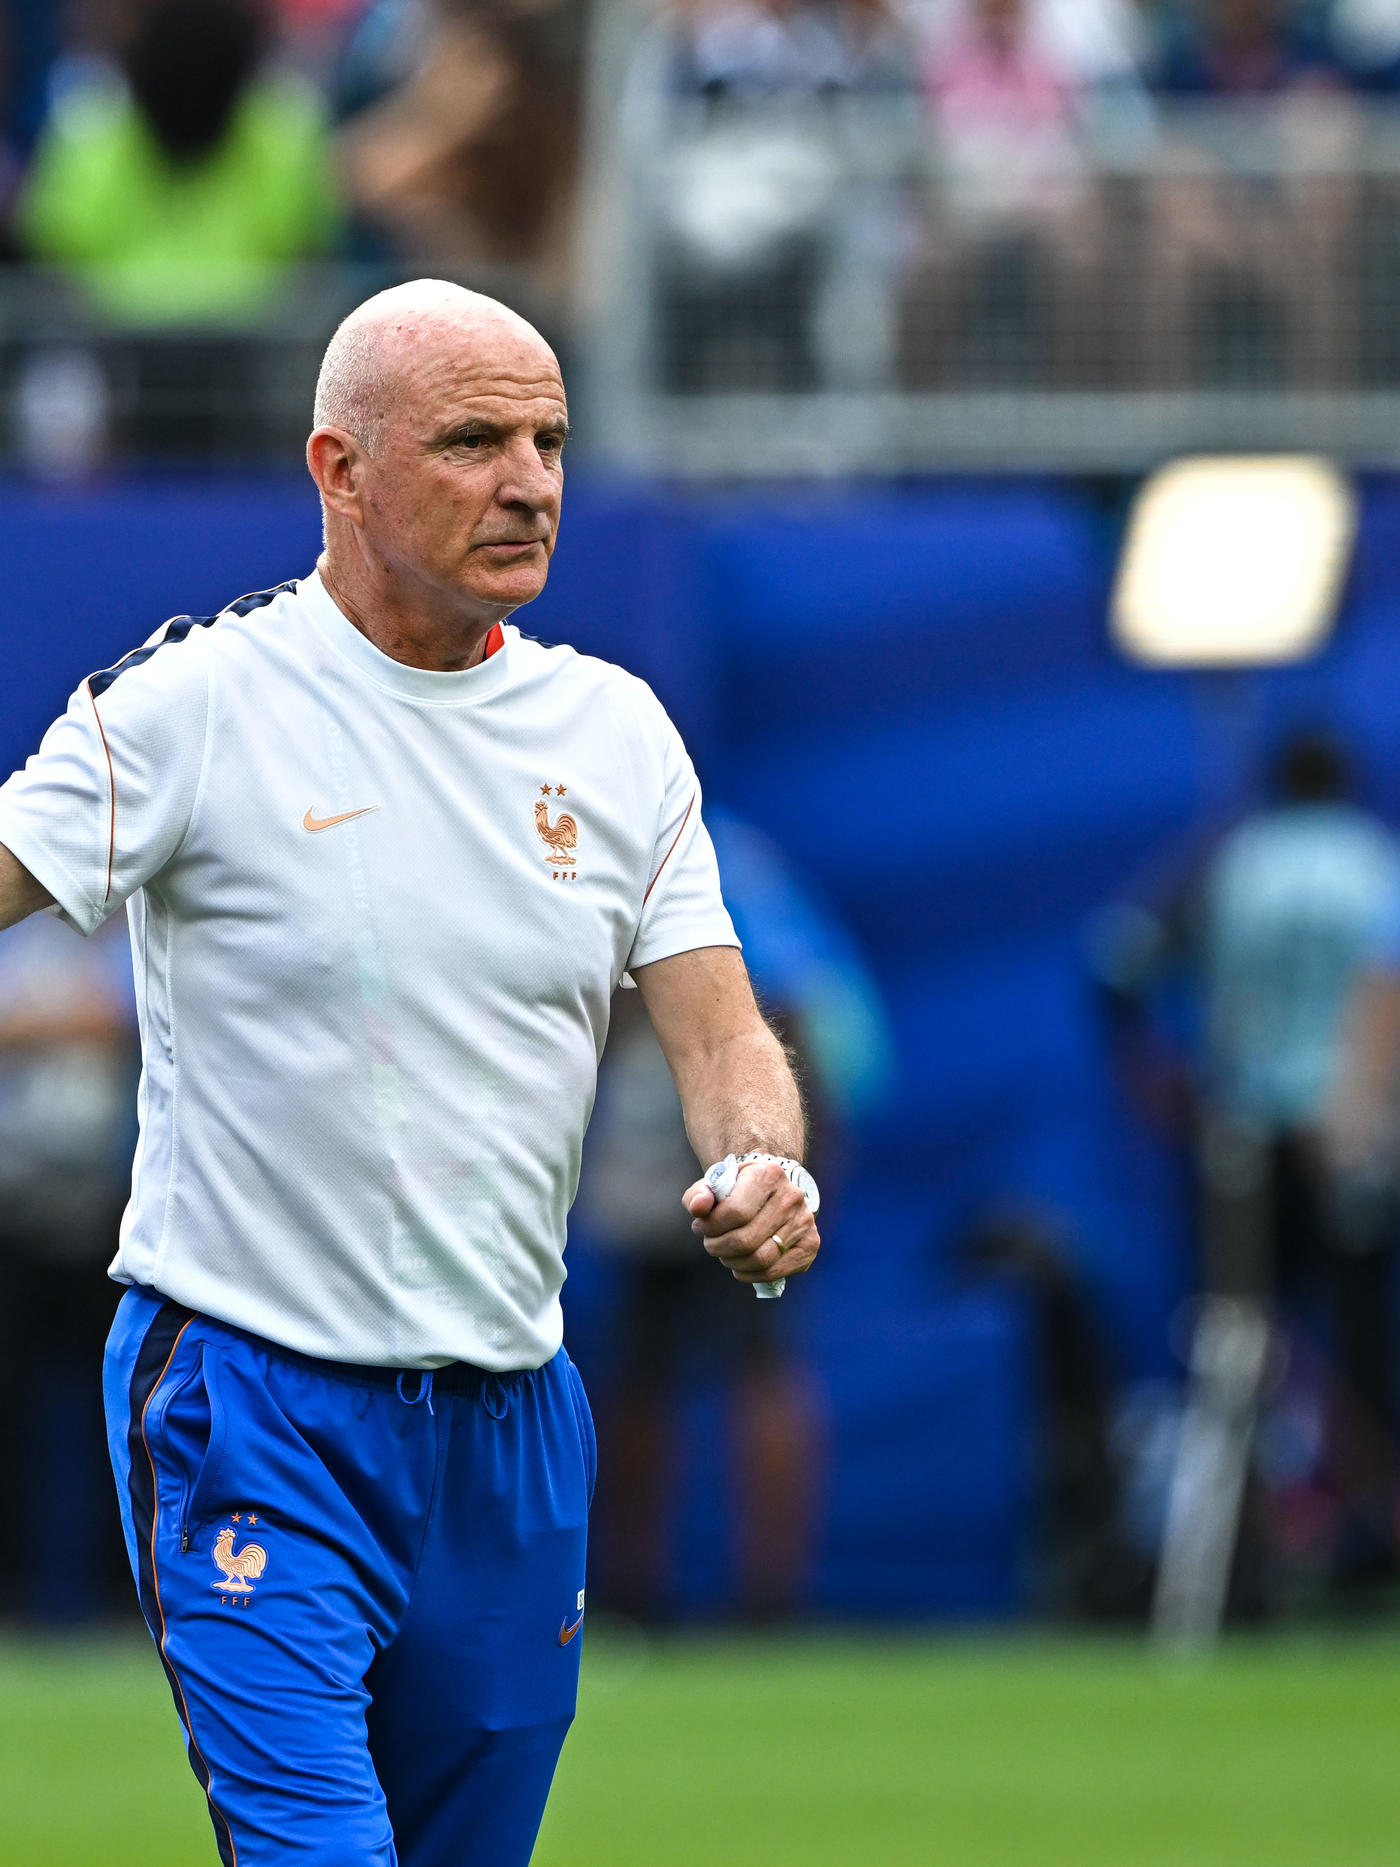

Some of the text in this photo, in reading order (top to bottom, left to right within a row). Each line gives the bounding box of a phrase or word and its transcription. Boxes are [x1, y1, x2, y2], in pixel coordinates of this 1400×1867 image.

[338, 796, 361, 867] WORD
[552, 871, 577, 881] FFF
[221, 1595, 251, 1607] FFF
